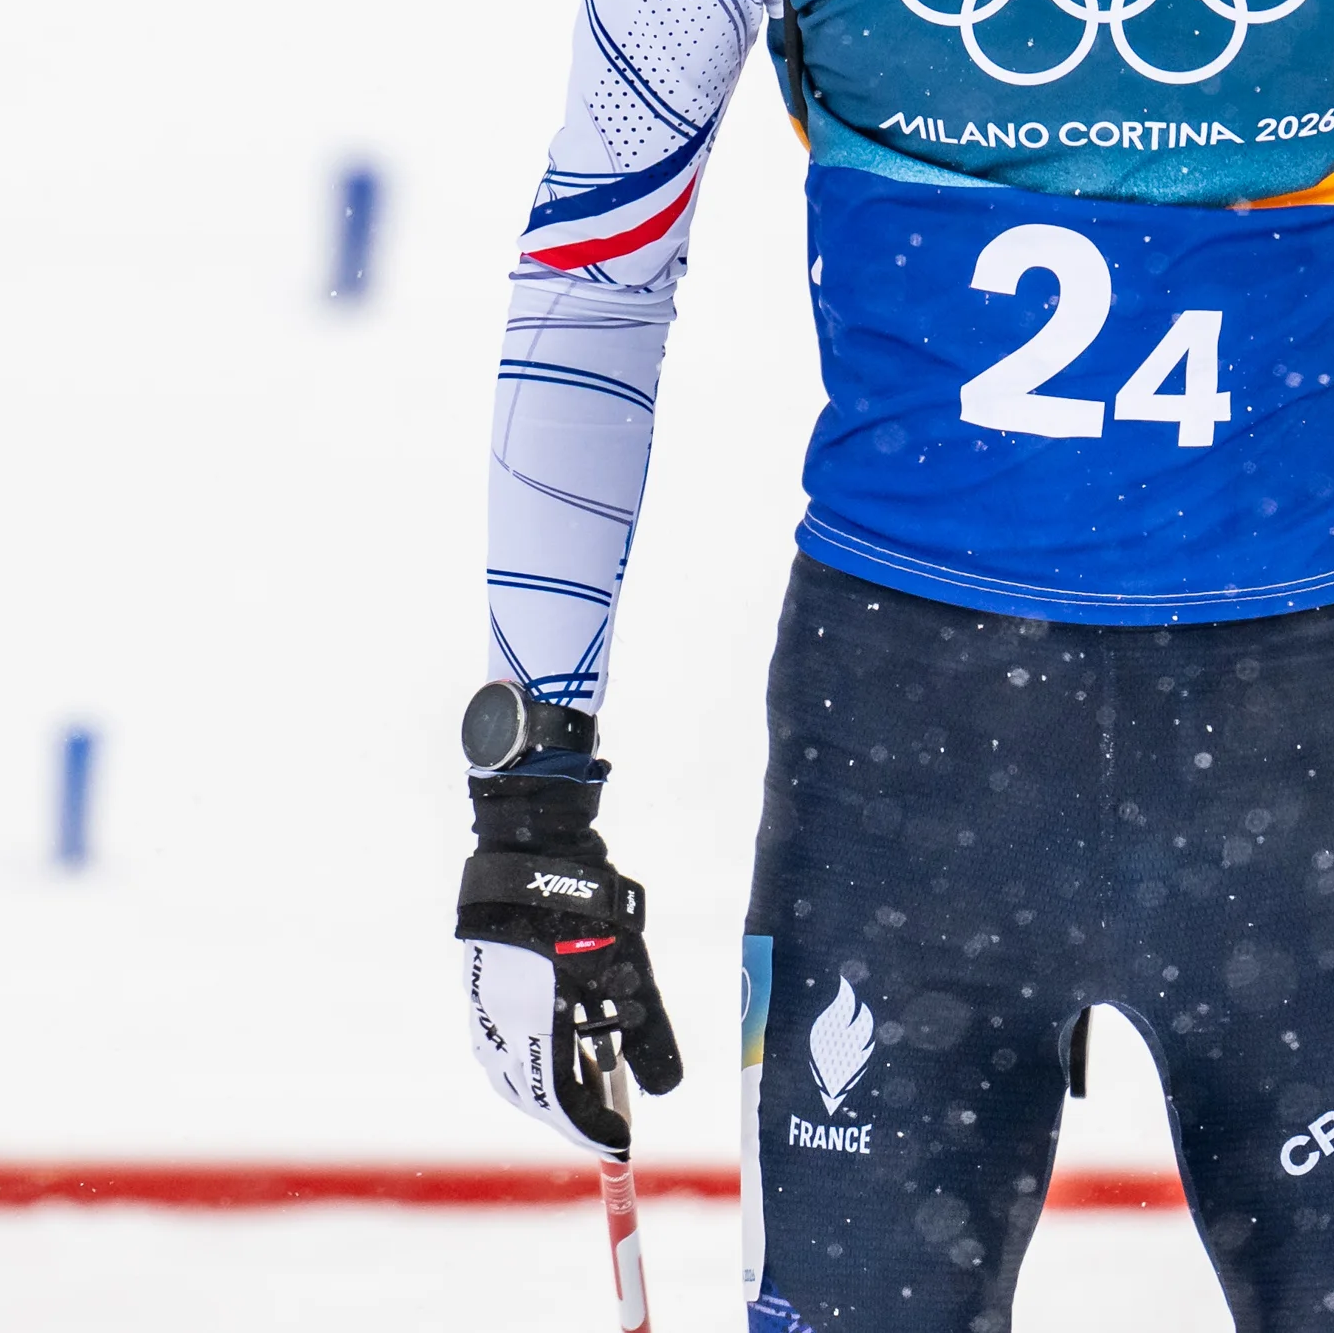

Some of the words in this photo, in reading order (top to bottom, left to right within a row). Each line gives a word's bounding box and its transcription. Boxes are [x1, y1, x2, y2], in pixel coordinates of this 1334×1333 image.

[878, 111, 1049, 149] MILANO
[1058, 120, 1245, 151] CORTINA
[626, 890, 636, 915] Right
[789, 1114, 873, 1155] FRANCE
